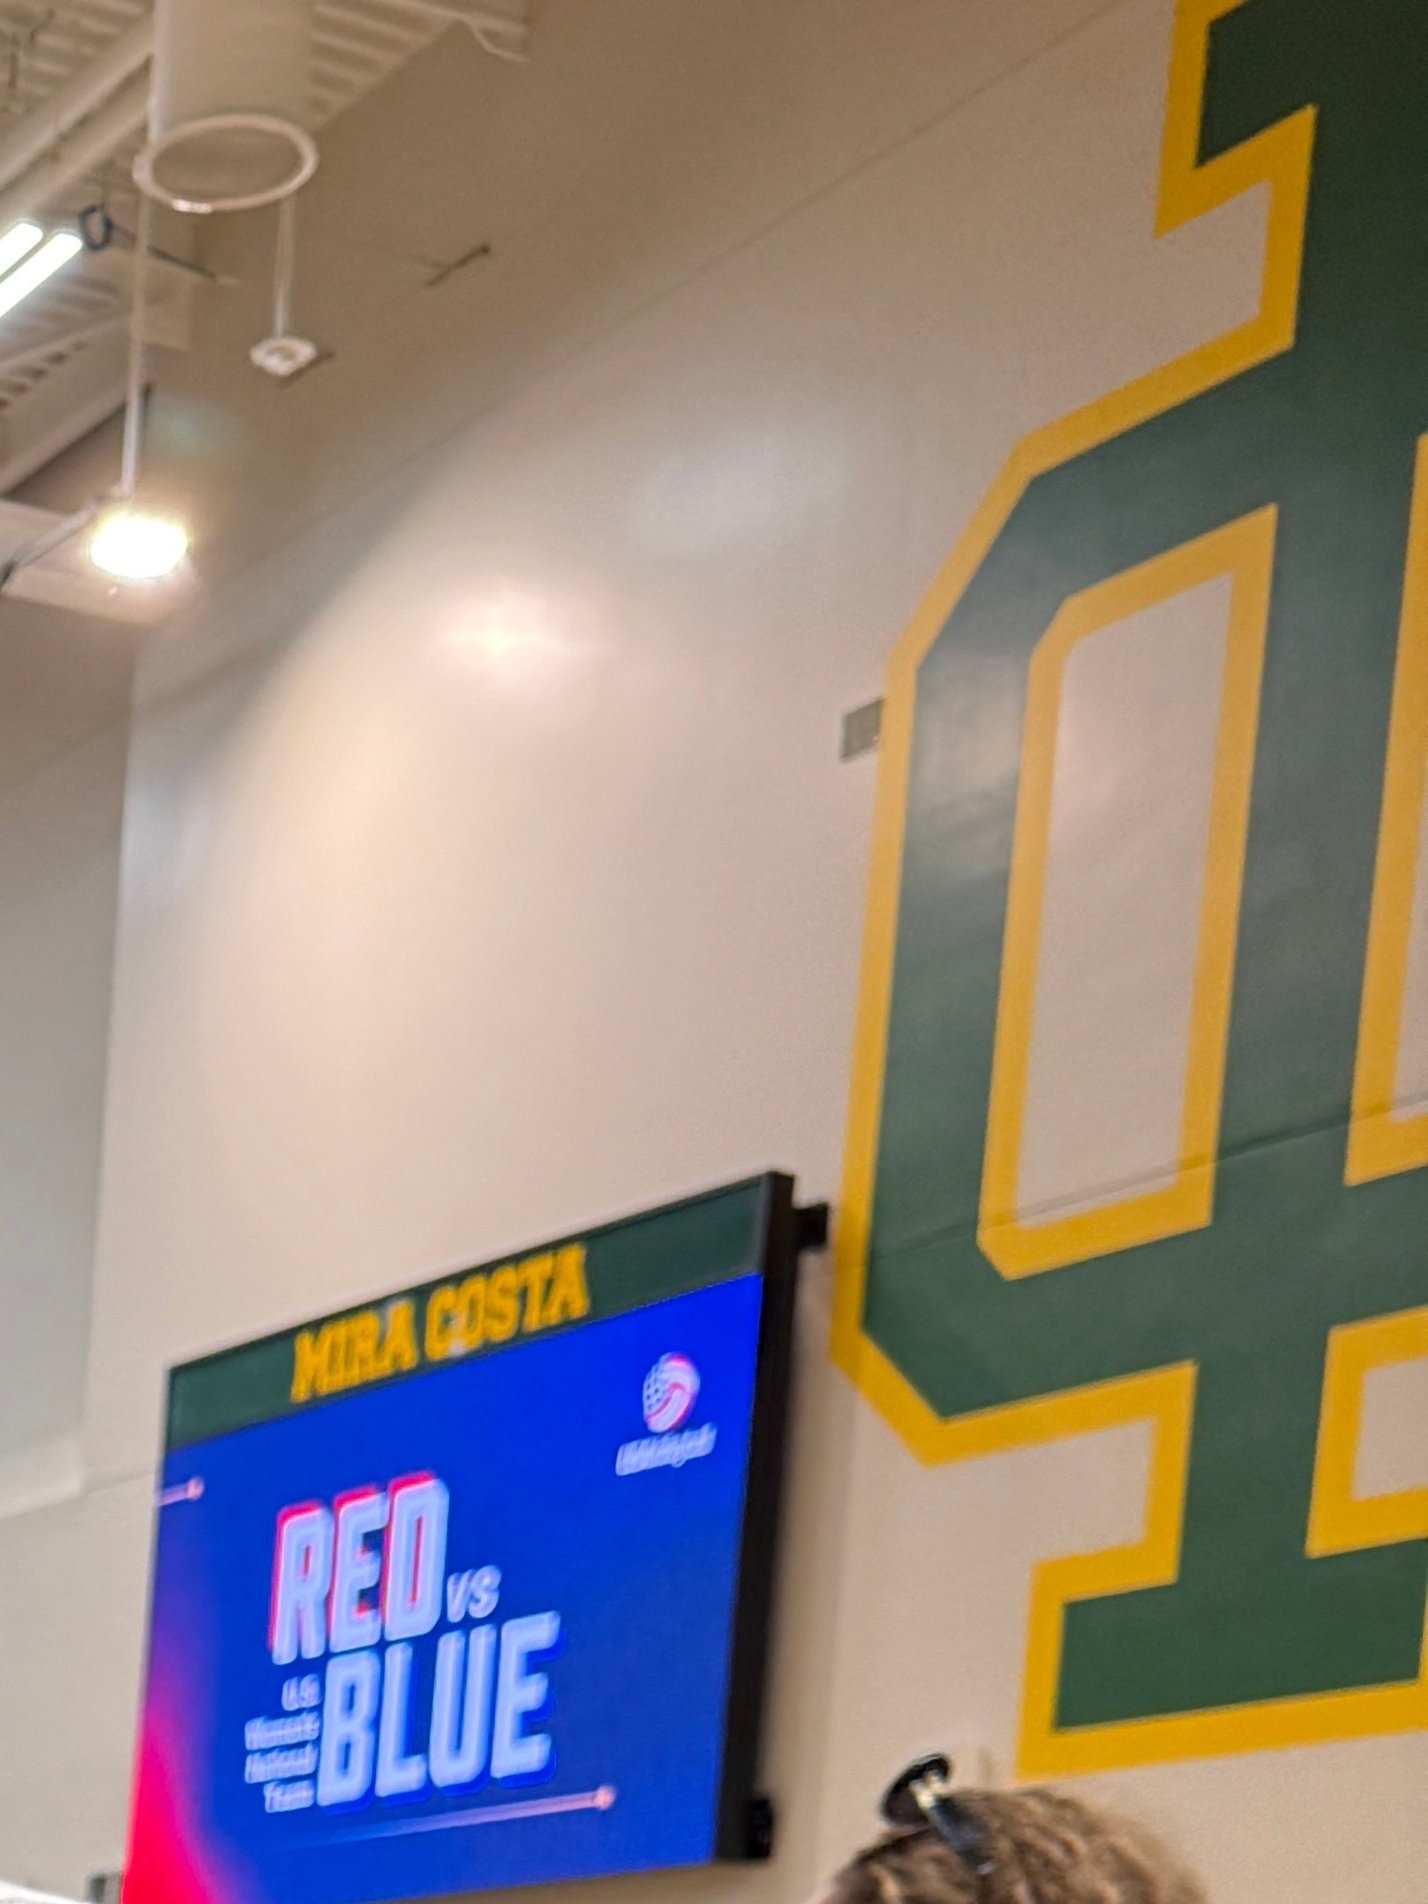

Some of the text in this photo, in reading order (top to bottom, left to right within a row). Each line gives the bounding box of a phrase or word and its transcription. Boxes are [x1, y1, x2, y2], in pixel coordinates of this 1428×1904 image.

[290, 1242, 590, 1404] MIRA COSTA
[268, 1471, 450, 1665] RED
[316, 1610, 561, 1807] BLUE
